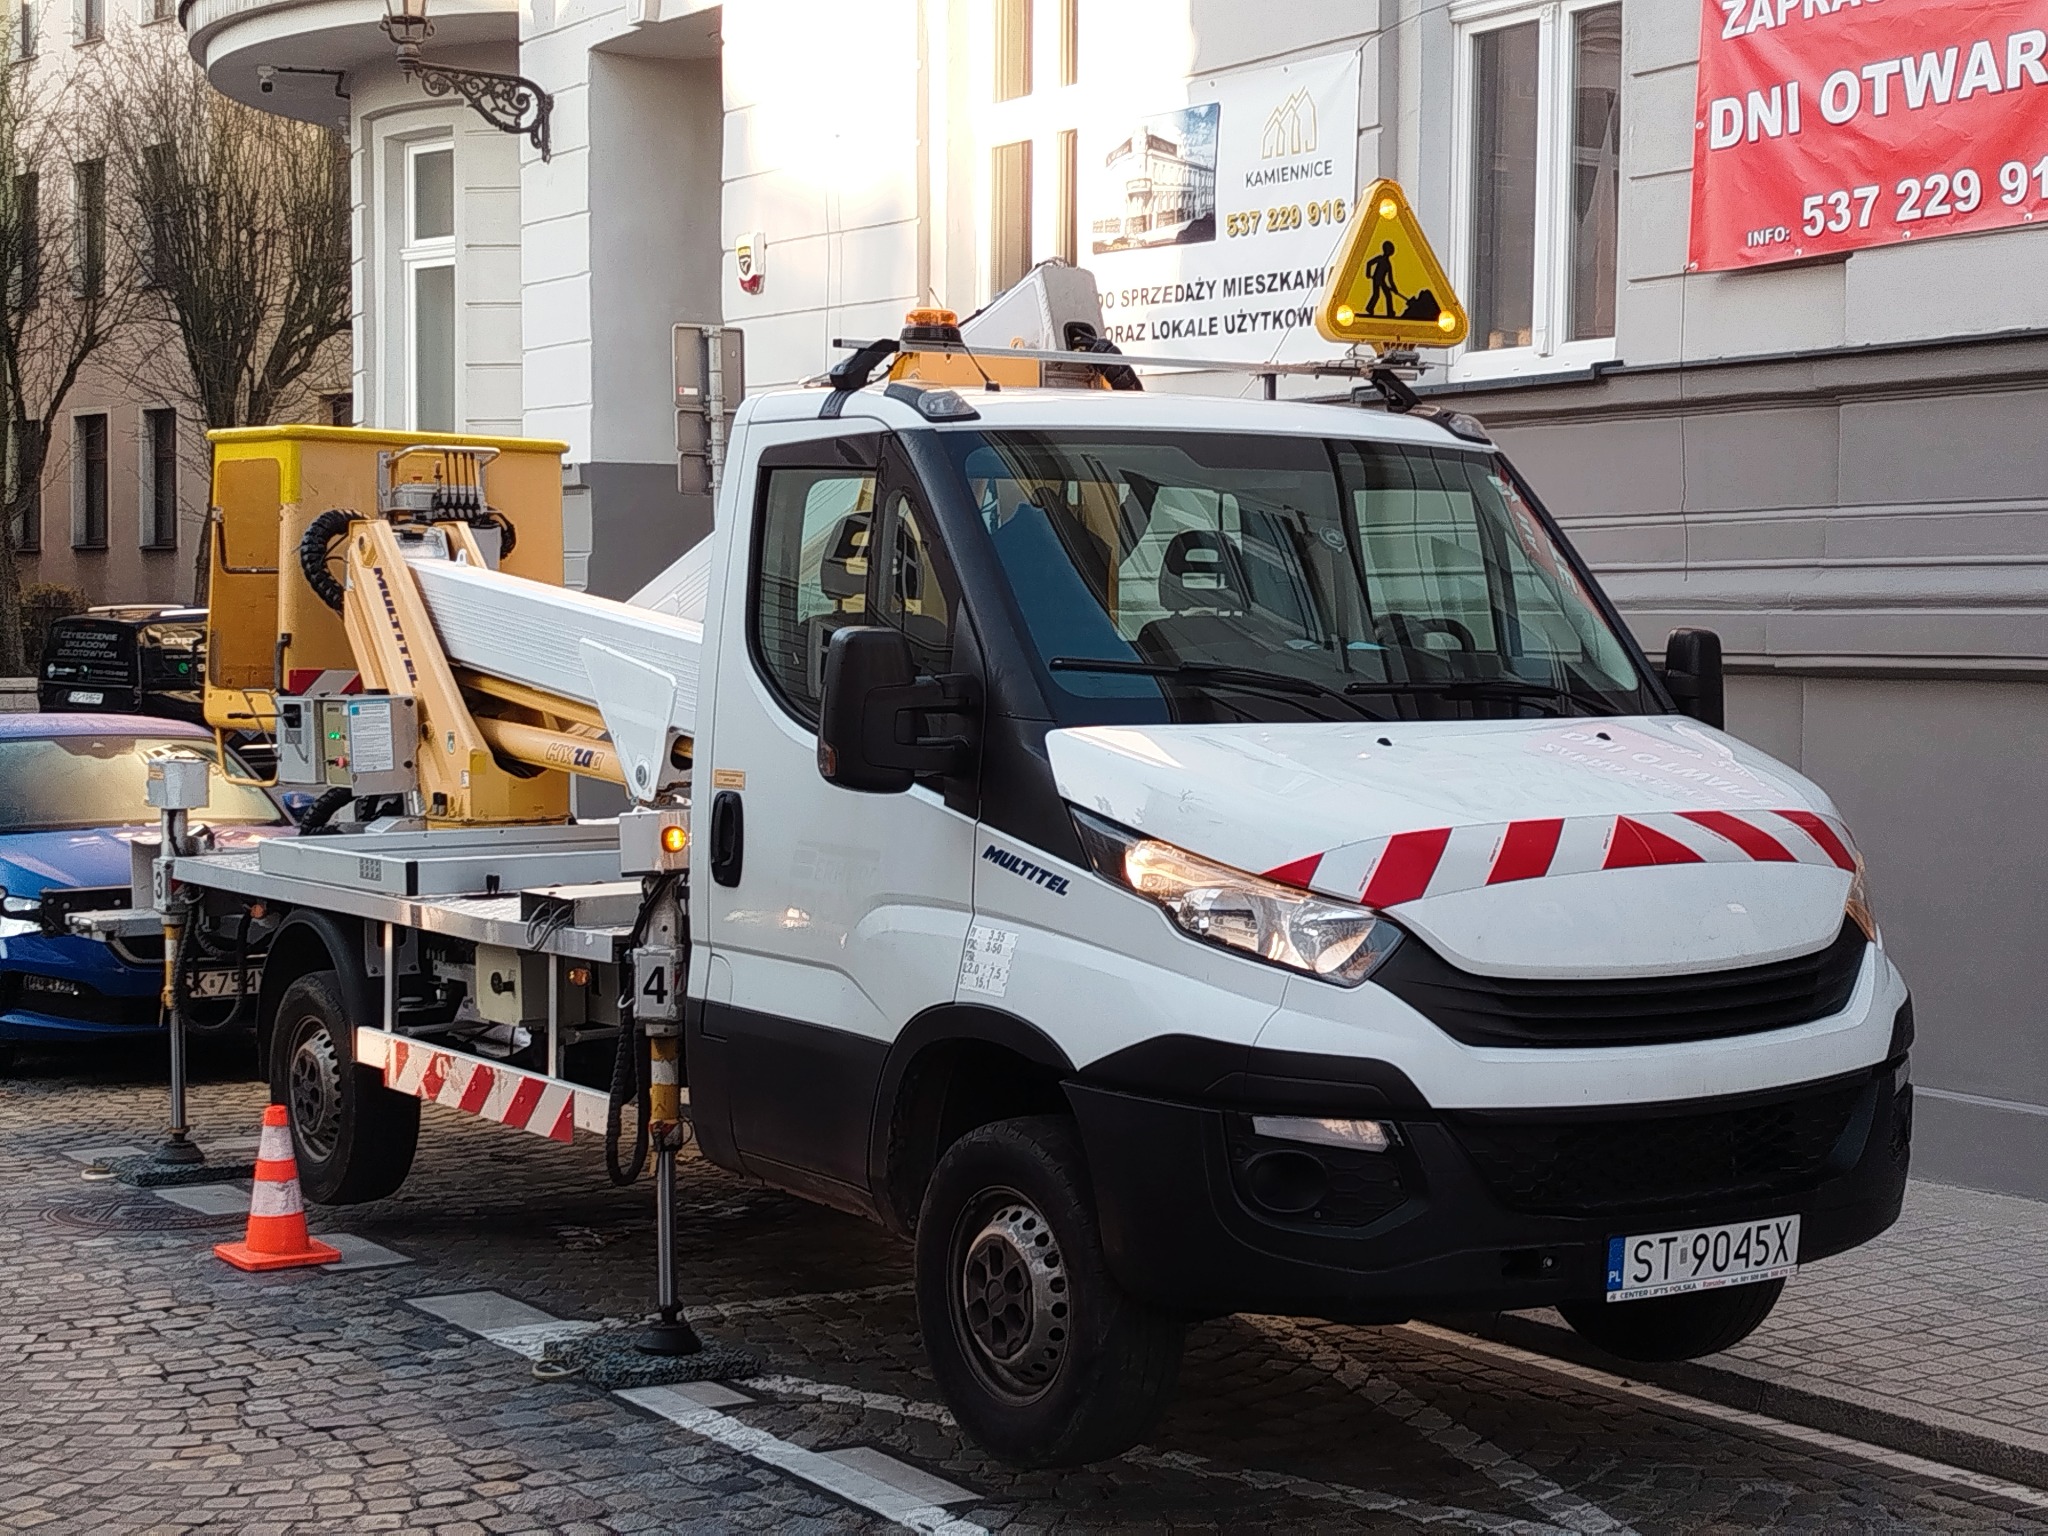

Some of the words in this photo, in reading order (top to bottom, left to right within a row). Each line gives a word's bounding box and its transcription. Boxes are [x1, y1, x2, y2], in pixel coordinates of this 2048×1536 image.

[1722, 0, 1886, 40] ZAP
[1709, 80, 1800, 150] DNI
[1820, 29, 2048, 127] OTWAR
[1245, 159, 1333, 188] KAMIENNICE
[1227, 211, 1262, 238] 537
[1266, 205, 1302, 232] 229
[1307, 198, 1345, 227] 916
[1747, 227, 1791, 247] INFO:
[1802, 185, 1880, 238] 537
[1896, 168, 1982, 222] 229
[2000, 155, 2048, 206] 91
[1121, 276, 1217, 308] SPRZEDAŻY
[1105, 323, 1146, 343] ORAZ
[1151, 316, 1218, 340] LOKALE
[1224, 307, 1318, 335] UŻYTKOW
[373, 567, 419, 689] MULTITEL
[154, 871, 163, 900] 3
[982, 844, 1071, 896] MULTITEL
[643, 966, 668, 1004] 4
[1633, 1236, 1678, 1283] ST
[1691, 1220, 1792, 1277] 9045X
[1608, 1271, 1622, 1283] PL
[1620, 1289, 1648, 1299] CENTER
[1649, 1285, 1668, 1296] LIFTS
[1669, 1282, 1697, 1294] POLSKA
